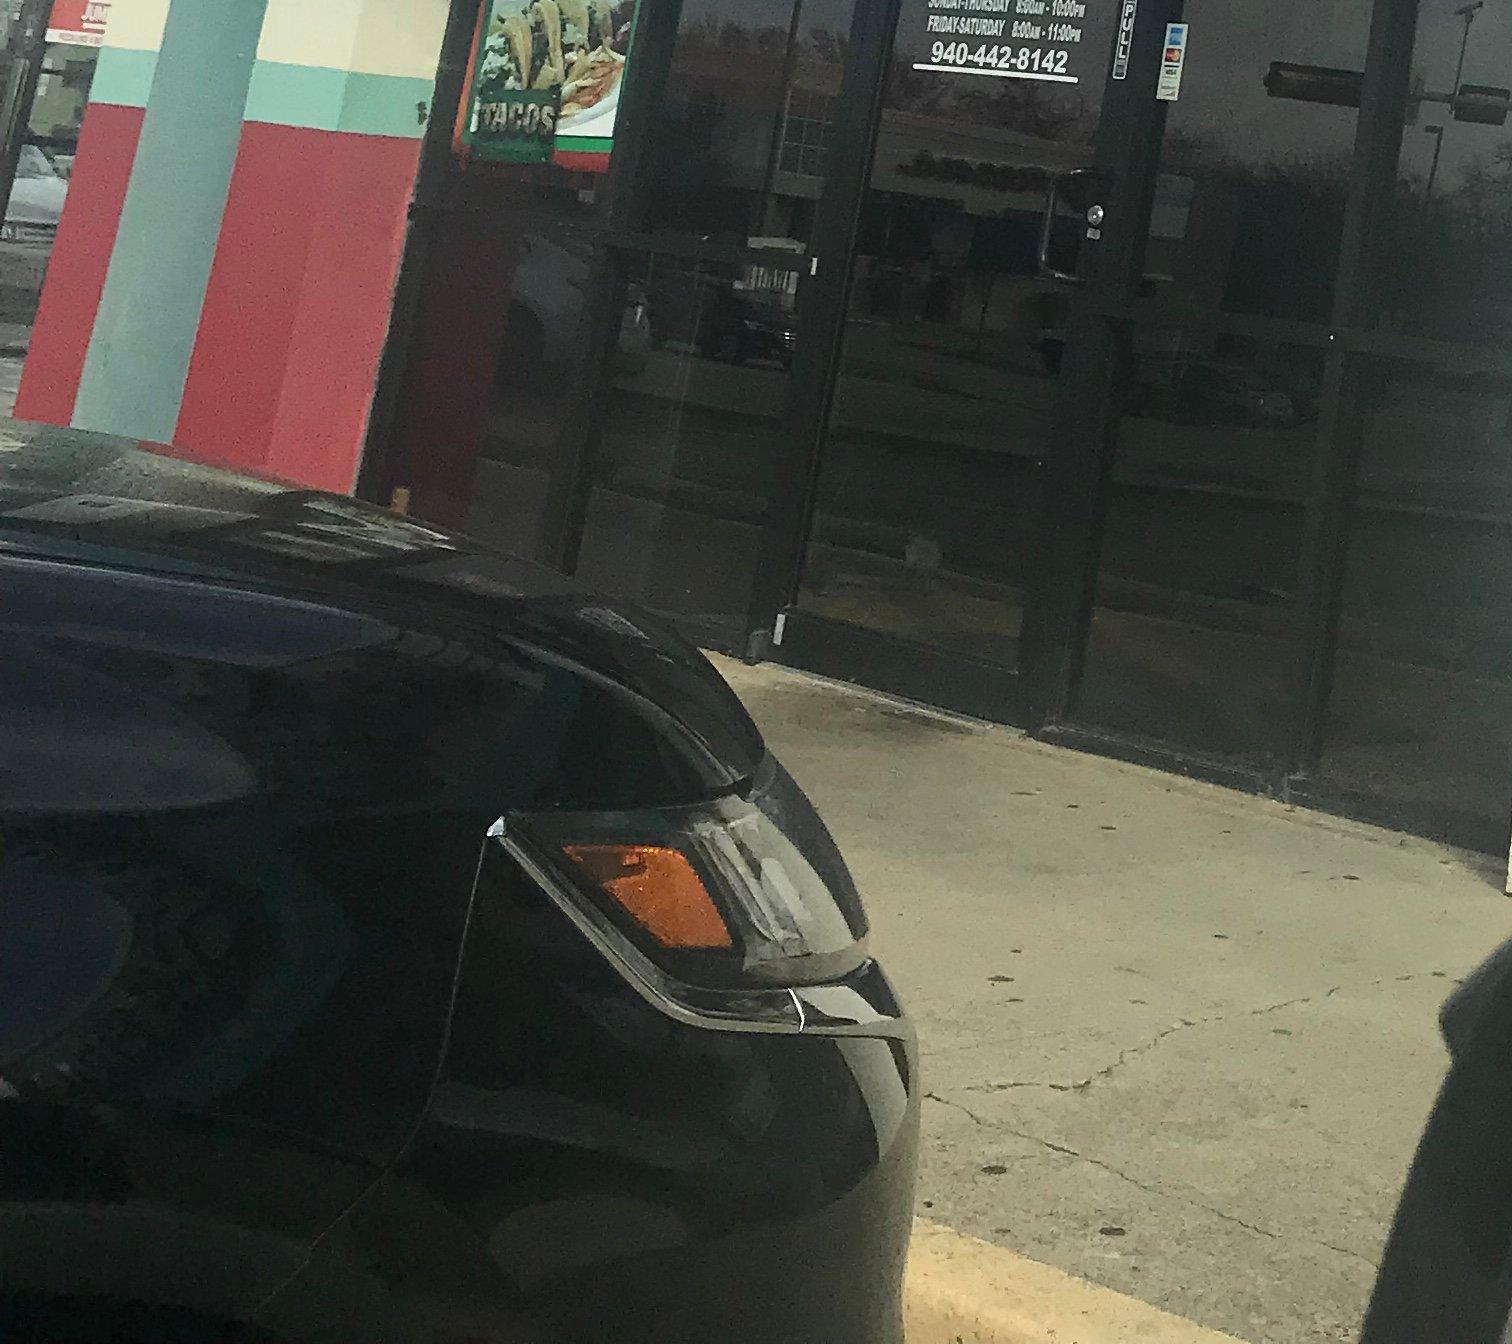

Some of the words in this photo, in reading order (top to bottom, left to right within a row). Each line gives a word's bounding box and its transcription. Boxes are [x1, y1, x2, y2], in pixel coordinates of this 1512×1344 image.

[926, 14, 1006, 36] FRIDAY-SATURDAY
[1118, 4, 1134, 59] PULL
[931, 41, 1069, 74] 940-442-8142
[481, 101, 555, 134] TACOS
